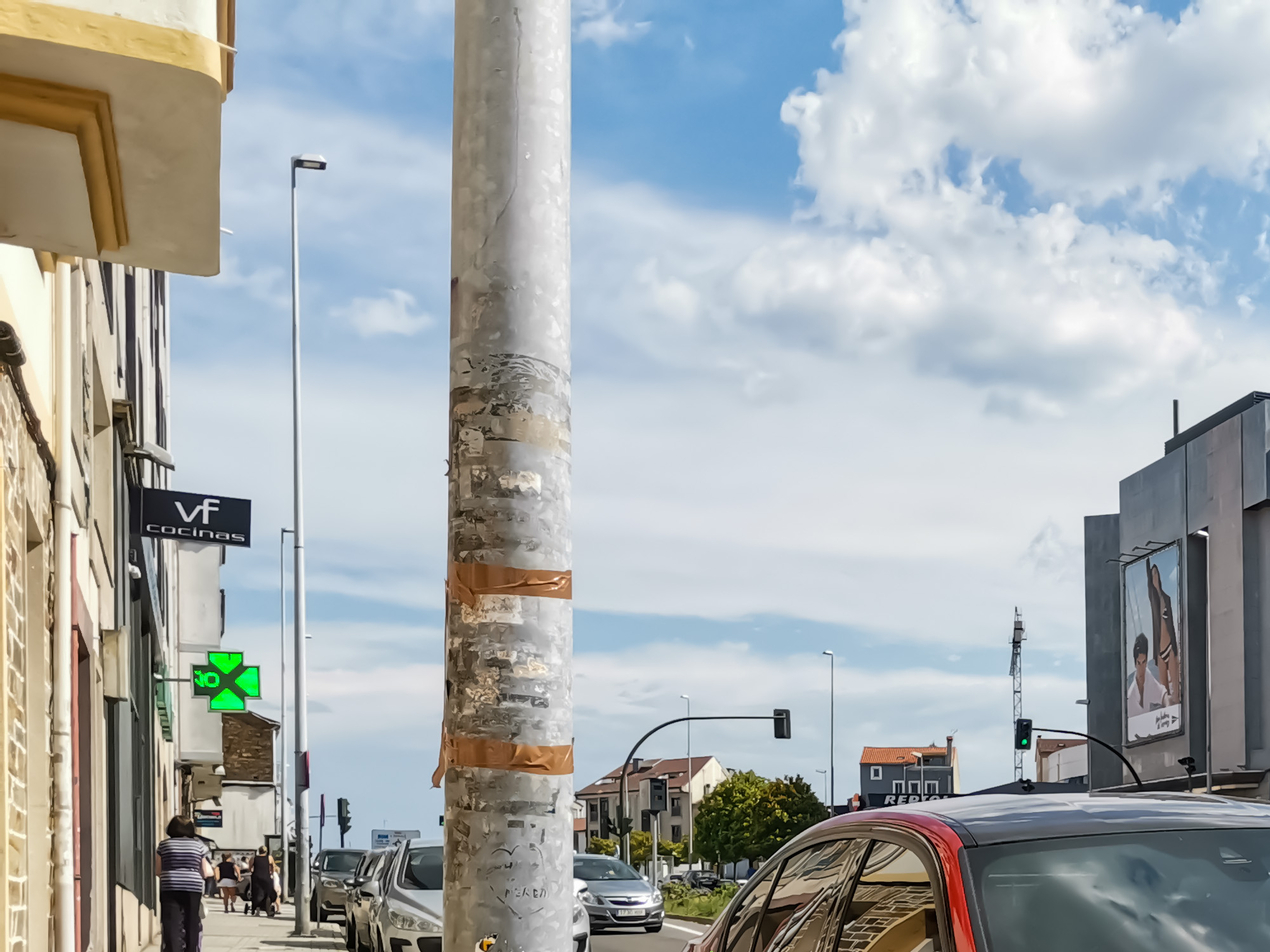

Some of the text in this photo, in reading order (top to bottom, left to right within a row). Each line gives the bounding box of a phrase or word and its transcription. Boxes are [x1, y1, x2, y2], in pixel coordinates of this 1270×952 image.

[174, 498, 221, 525] vf
[146, 524, 246, 542] cocinas
[884, 795, 948, 805] REPO
